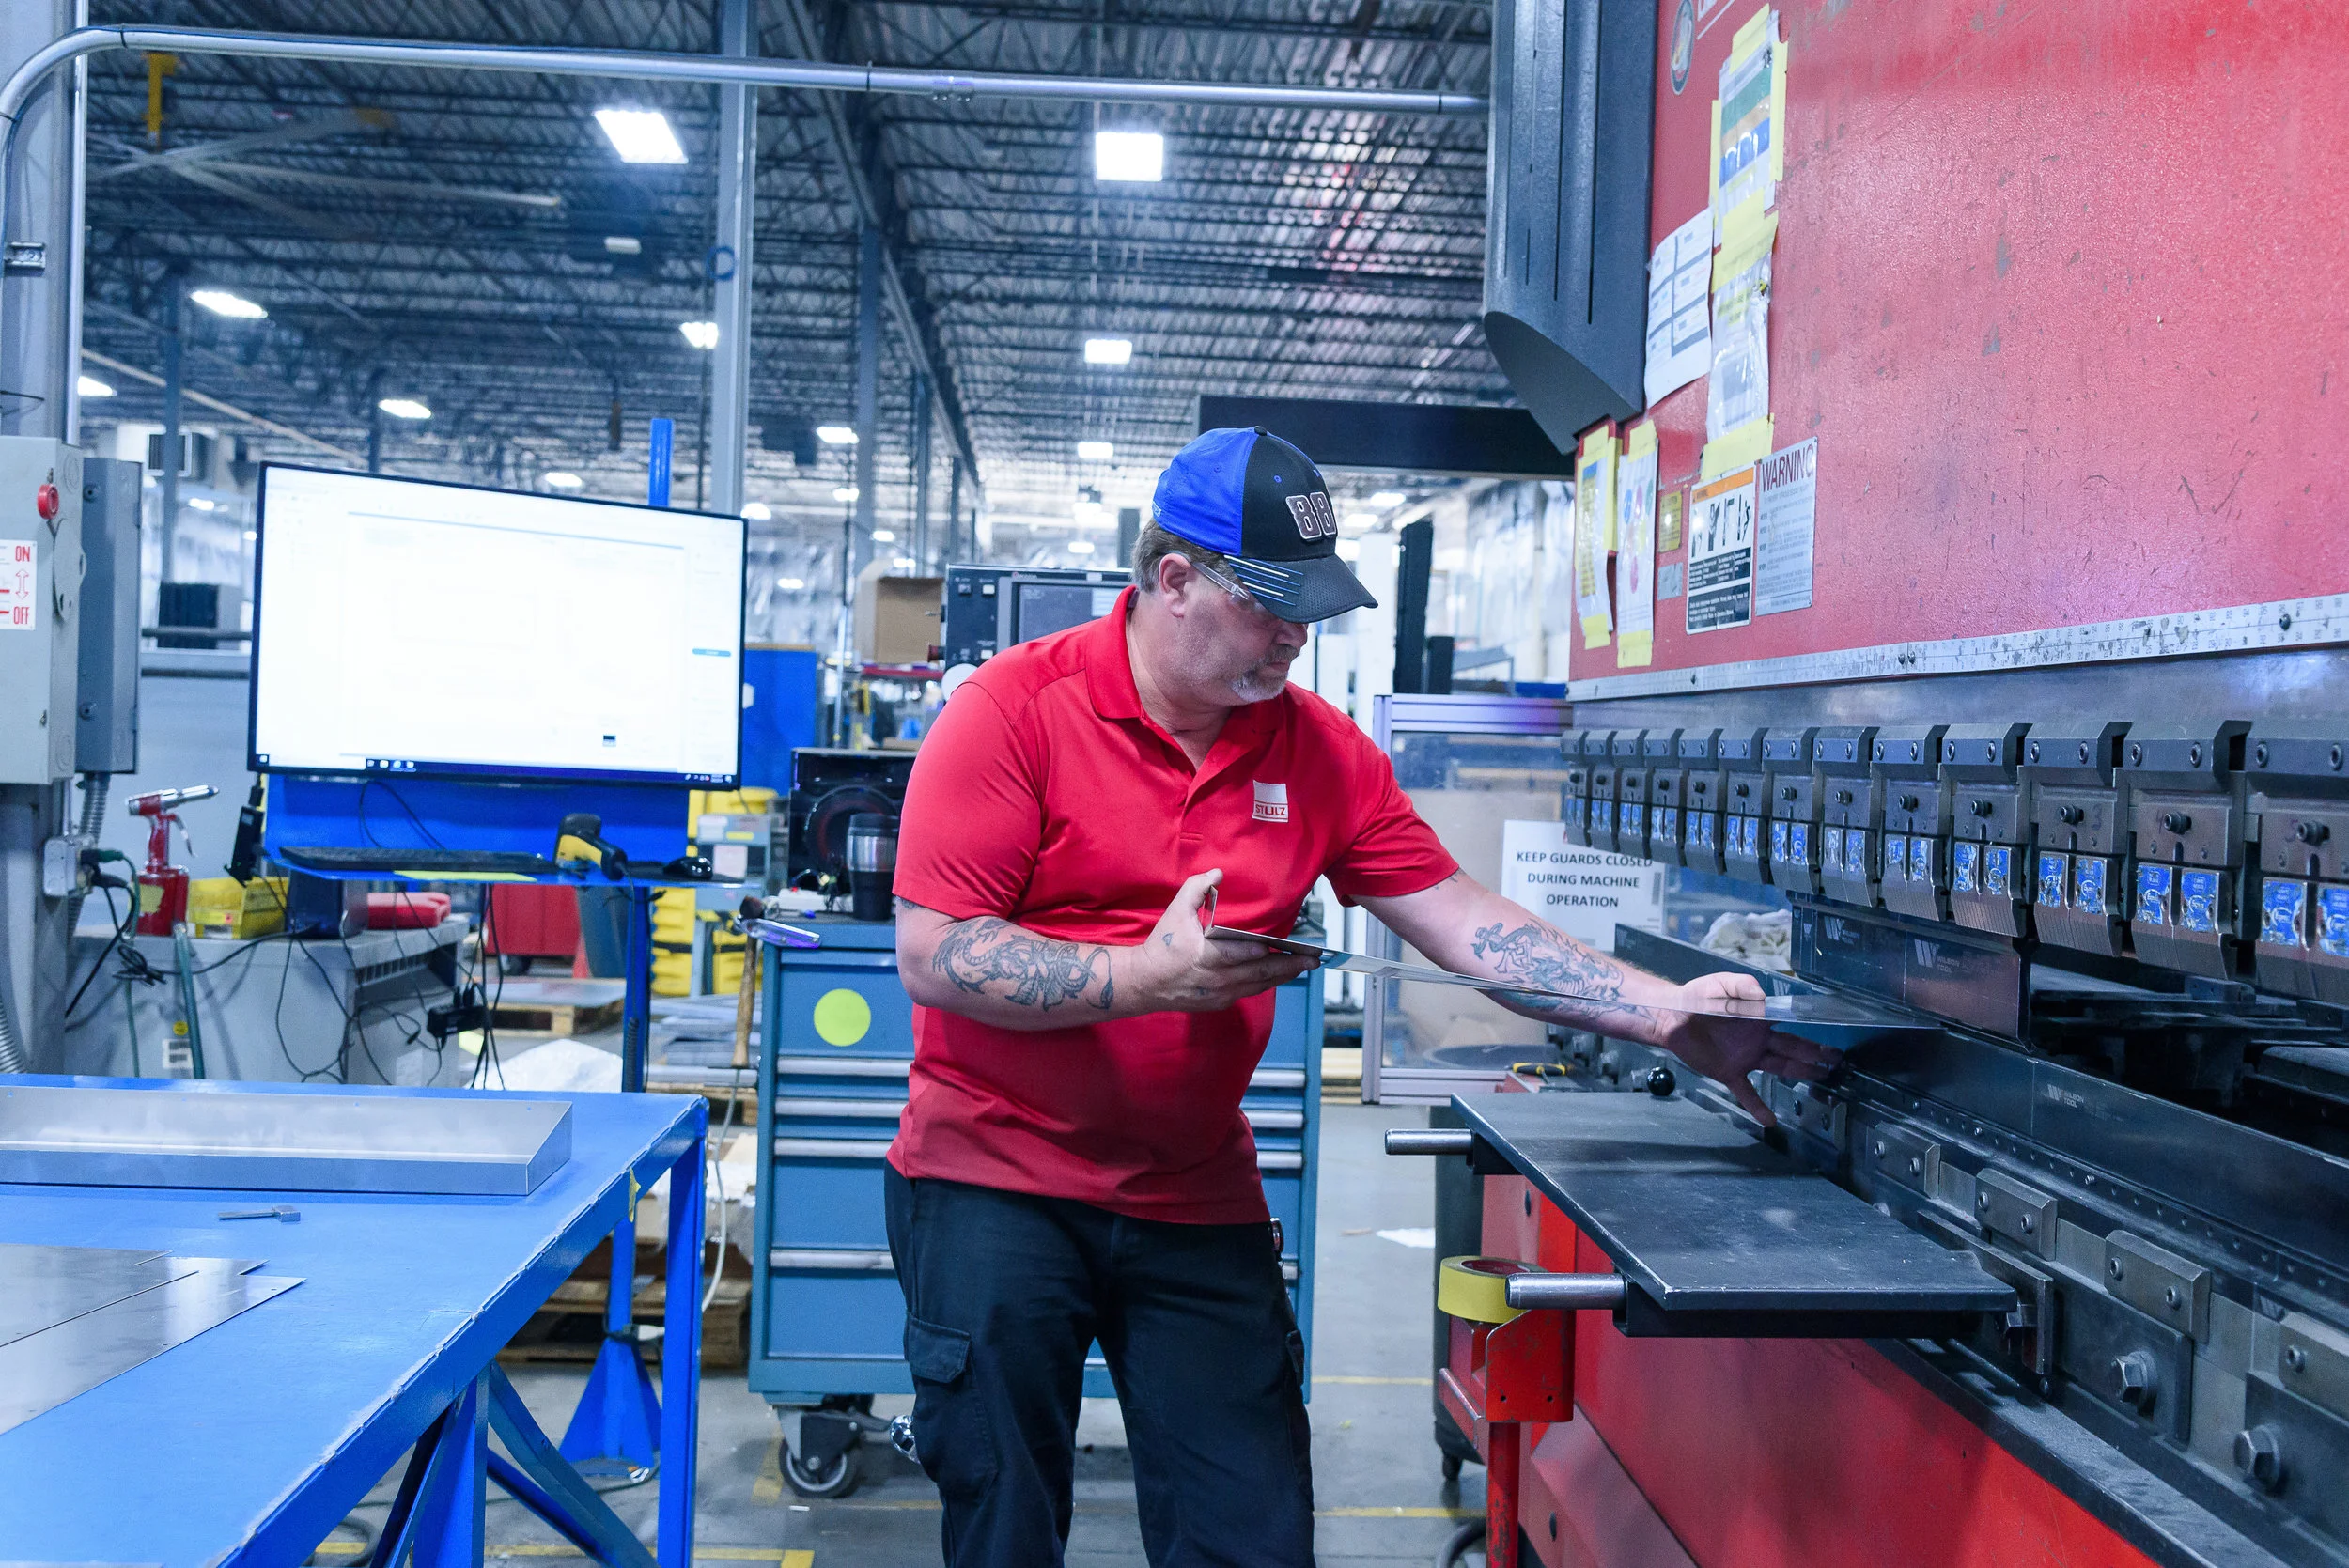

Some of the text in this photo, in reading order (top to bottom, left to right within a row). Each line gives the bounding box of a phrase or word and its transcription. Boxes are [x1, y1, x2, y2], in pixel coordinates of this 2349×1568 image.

[1762, 443, 1814, 492] WARNING
[1285, 491, 1338, 539] 88
[15, 545, 31, 563] ON
[13, 606, 30, 625] OFF
[1255, 804, 1286, 815] STULZ
[1517, 851, 1653, 867] KEEP GUARDS CLOSED
[1527, 873, 1640, 888] DURING MACHINE
[1546, 893, 1619, 908] OPERATION
